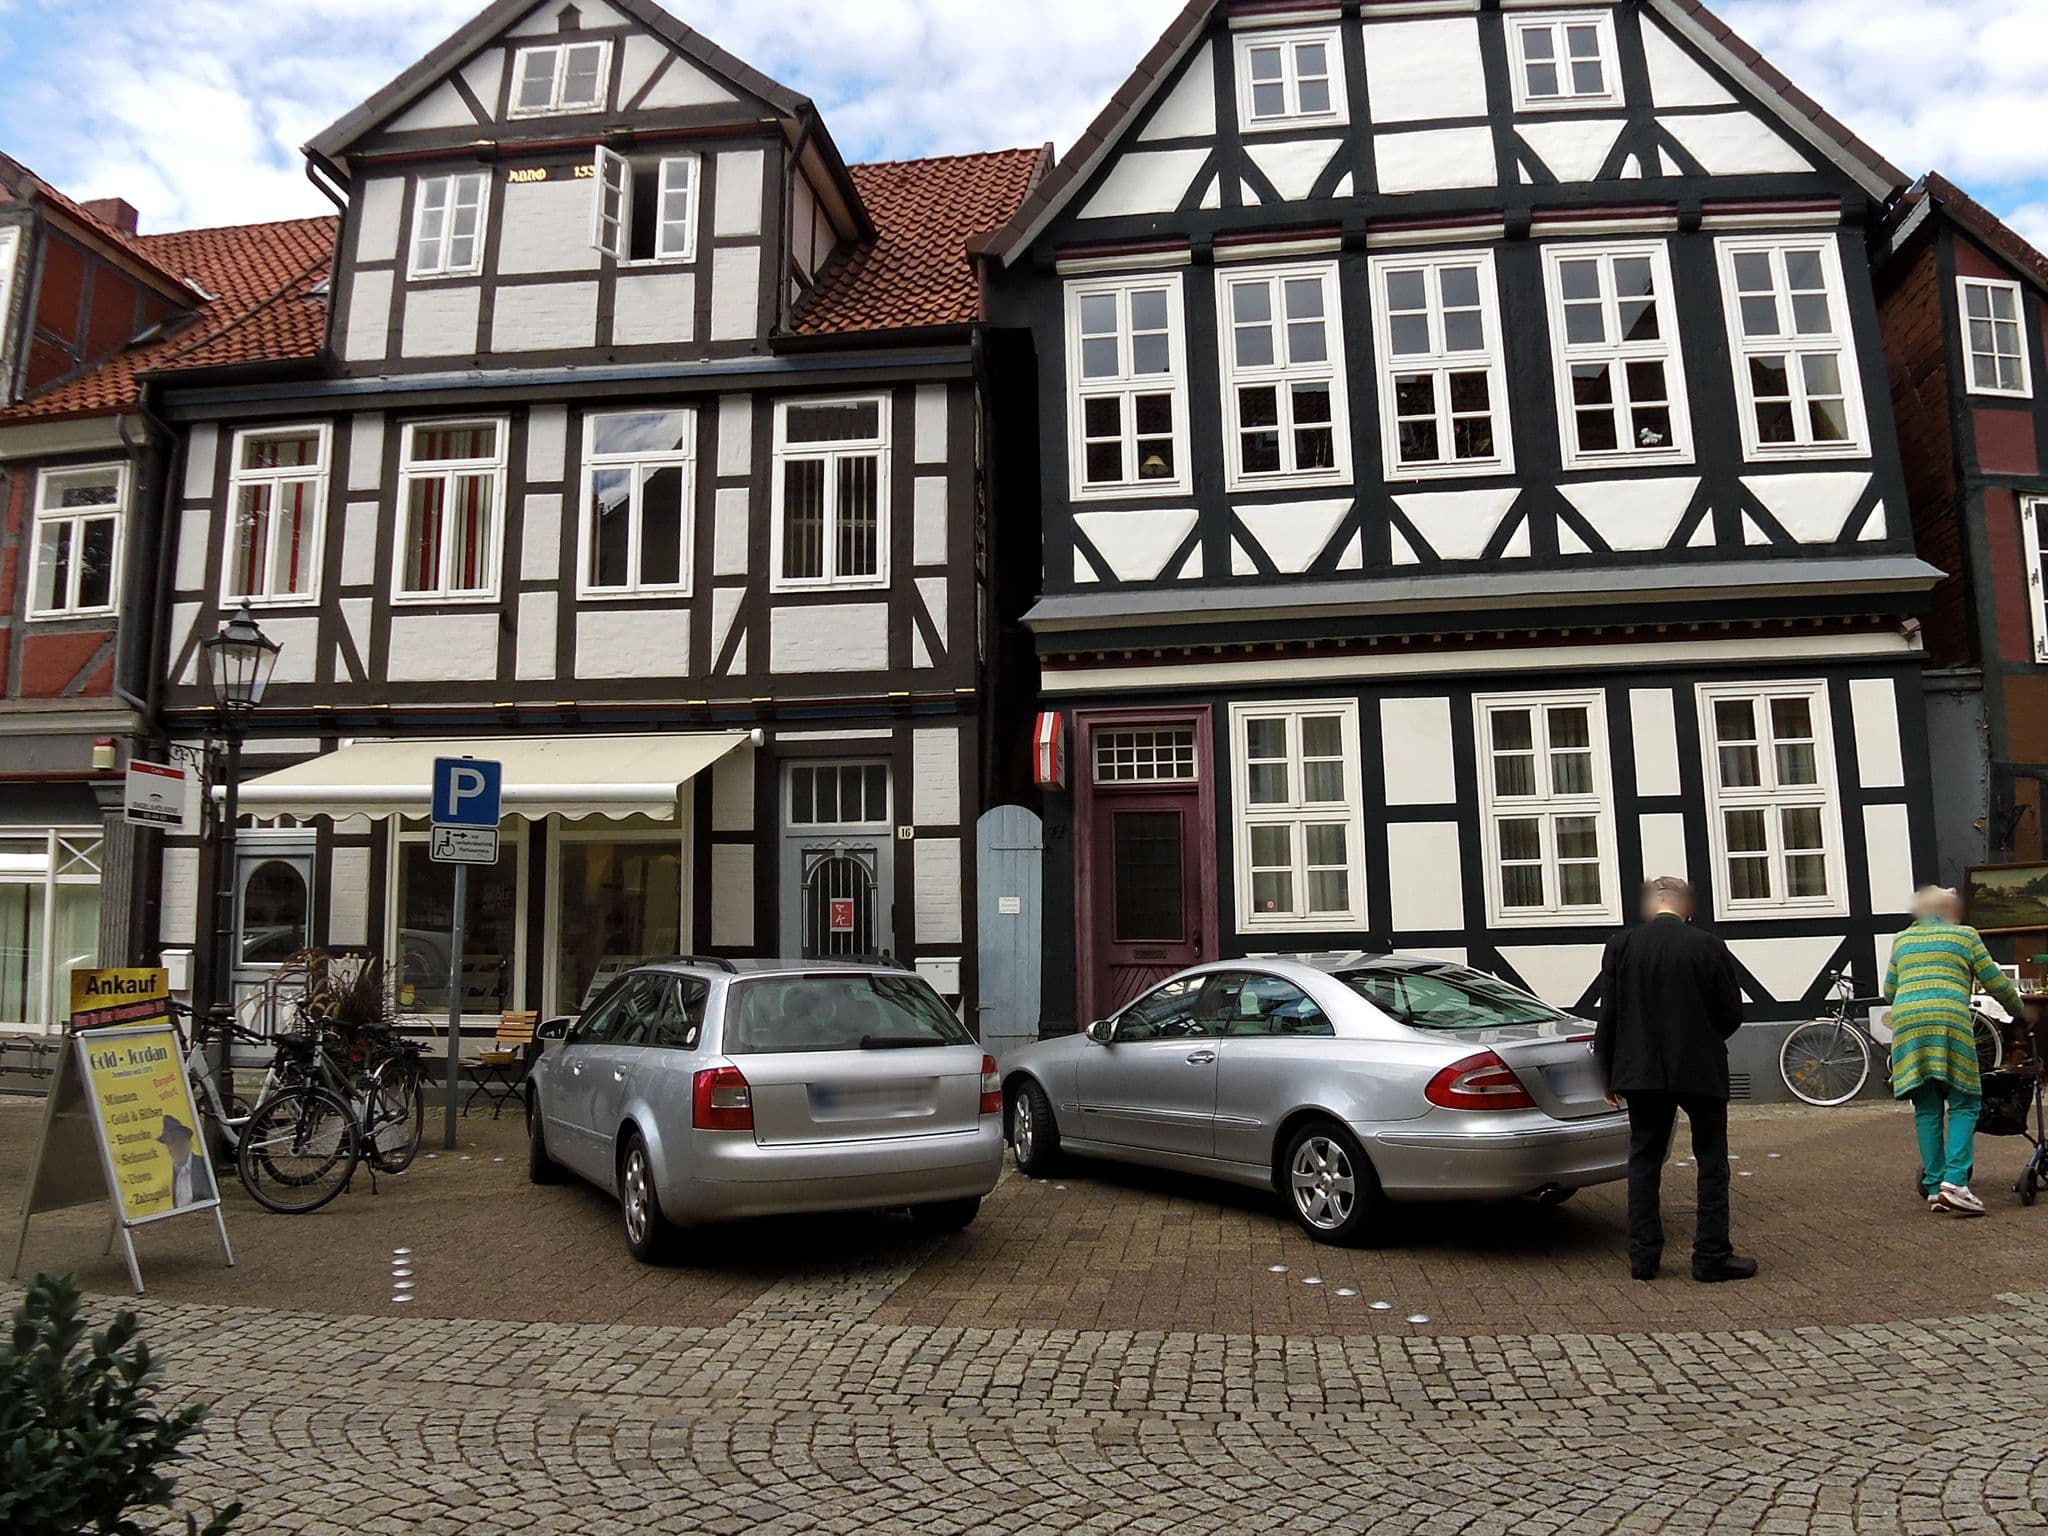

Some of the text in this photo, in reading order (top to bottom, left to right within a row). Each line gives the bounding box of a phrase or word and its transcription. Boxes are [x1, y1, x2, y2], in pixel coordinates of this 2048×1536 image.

[449, 766, 486, 816] P
[902, 828, 911, 837] 16
[85, 973, 157, 995] Ankauf
